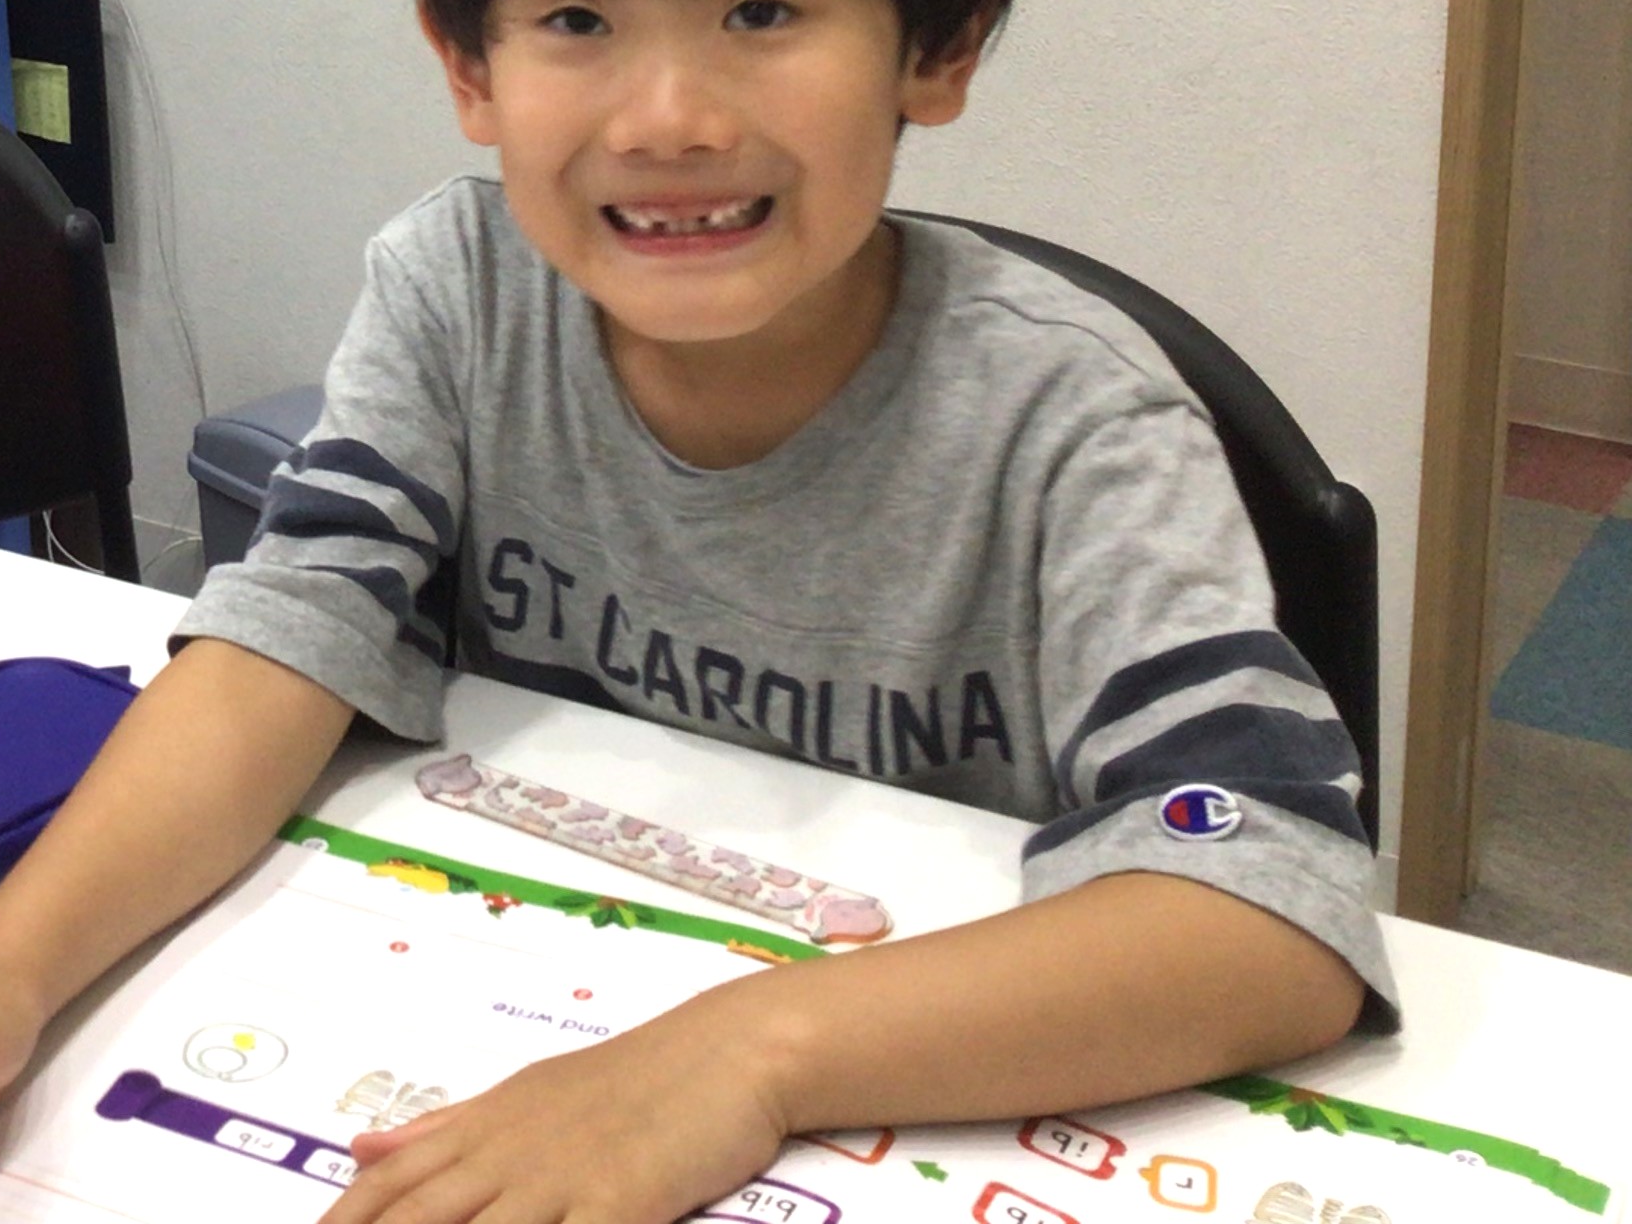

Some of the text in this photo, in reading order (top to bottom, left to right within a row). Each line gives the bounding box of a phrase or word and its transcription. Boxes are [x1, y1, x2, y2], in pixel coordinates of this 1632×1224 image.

[483, 537, 1014, 776] ST CAROLINA
[559, 1018, 610, 1037] and
[239, 1132, 274, 1150] rib
[1051, 1130, 1089, 1157] ib
[1455, 1153, 1478, 1167] 26
[741, 1190, 798, 1223] bib
